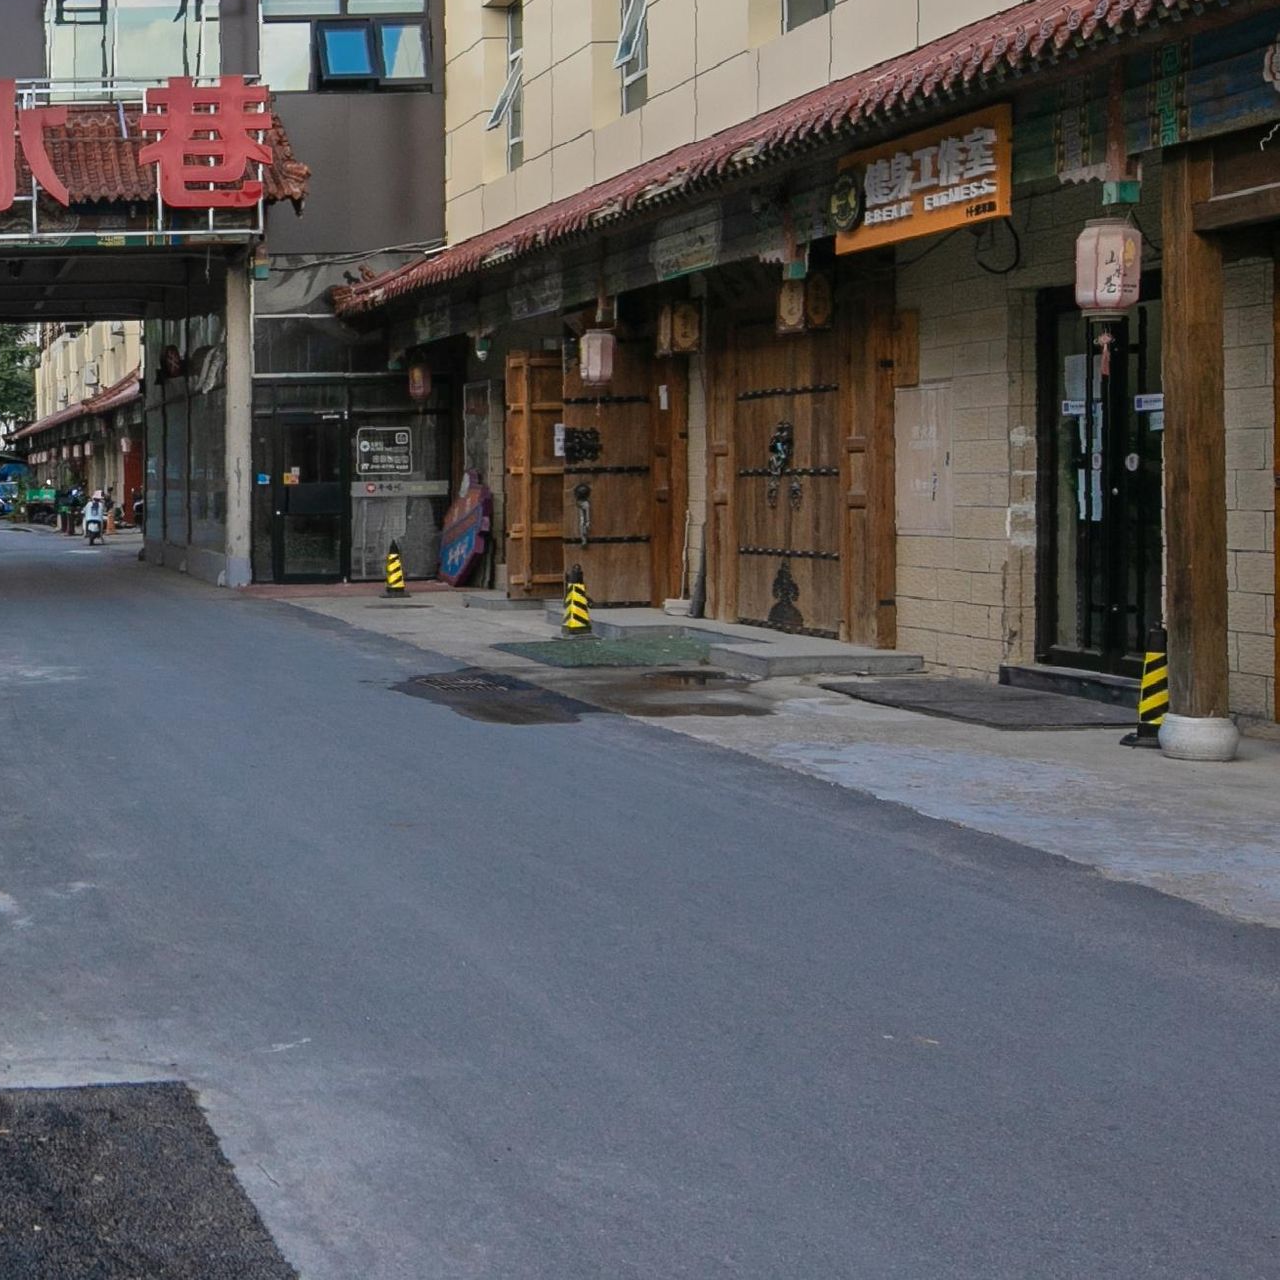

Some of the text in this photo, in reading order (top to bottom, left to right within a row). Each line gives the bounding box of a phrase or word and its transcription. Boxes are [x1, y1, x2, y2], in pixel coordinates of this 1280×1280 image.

[864, 127, 997, 208] 健身工作室
